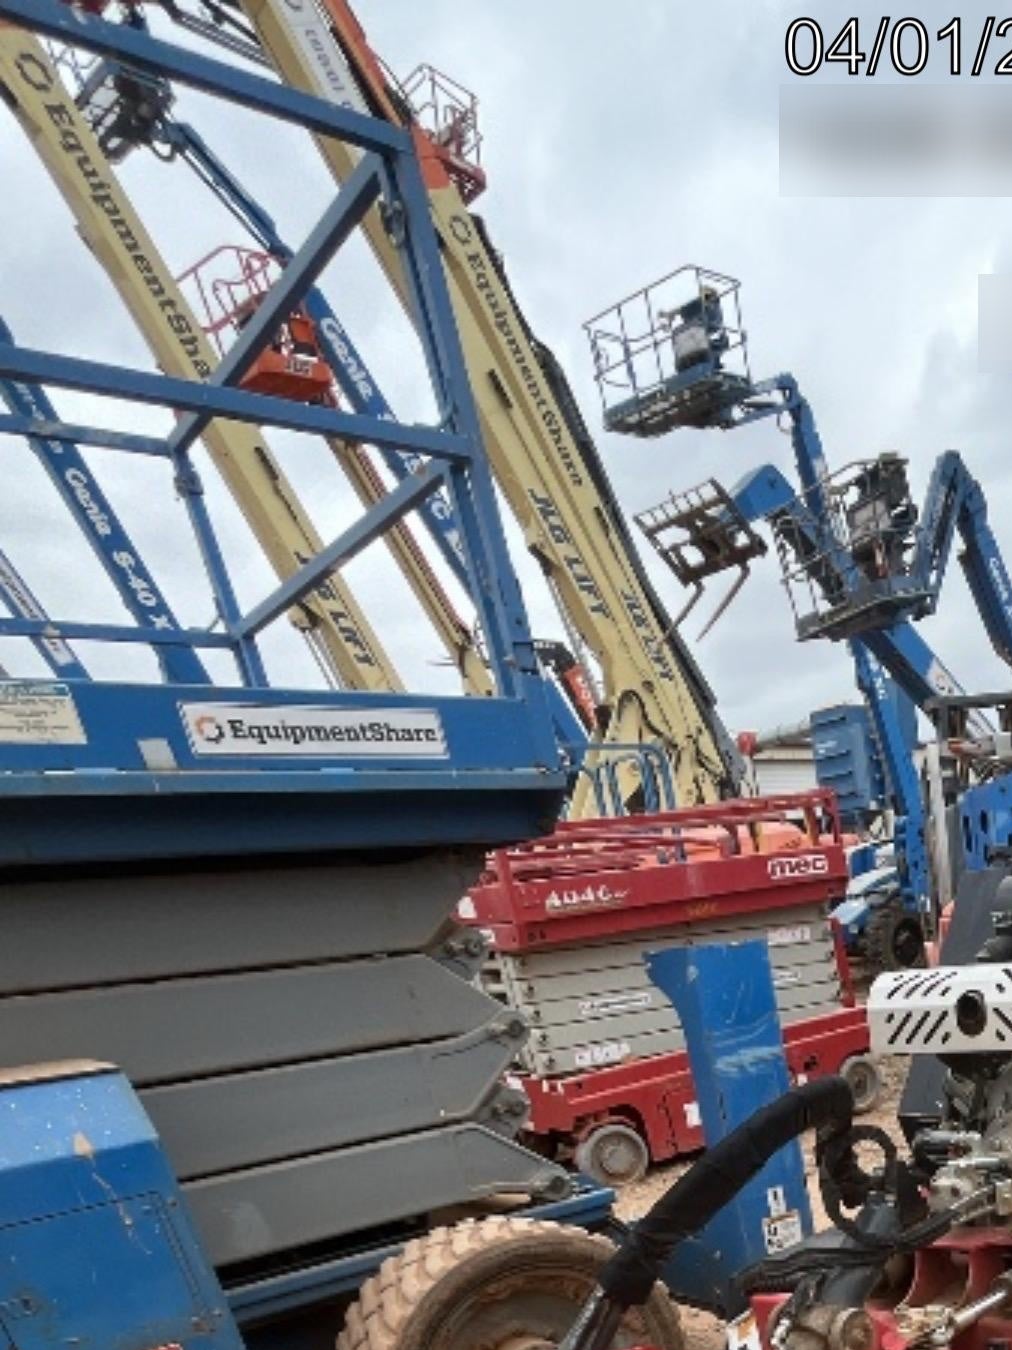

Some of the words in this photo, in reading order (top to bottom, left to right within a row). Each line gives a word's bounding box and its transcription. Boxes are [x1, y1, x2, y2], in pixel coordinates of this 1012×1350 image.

[45, 102, 213, 380] EquipmentSha
[320, 316, 373, 401] Genie
[65, 466, 111, 536] Genie
[113, 550, 156, 607] S-40
[527, 487, 574, 547] JLG
[564, 556, 619, 621] LIFT
[227, 719, 438, 745] EquipmentShare
